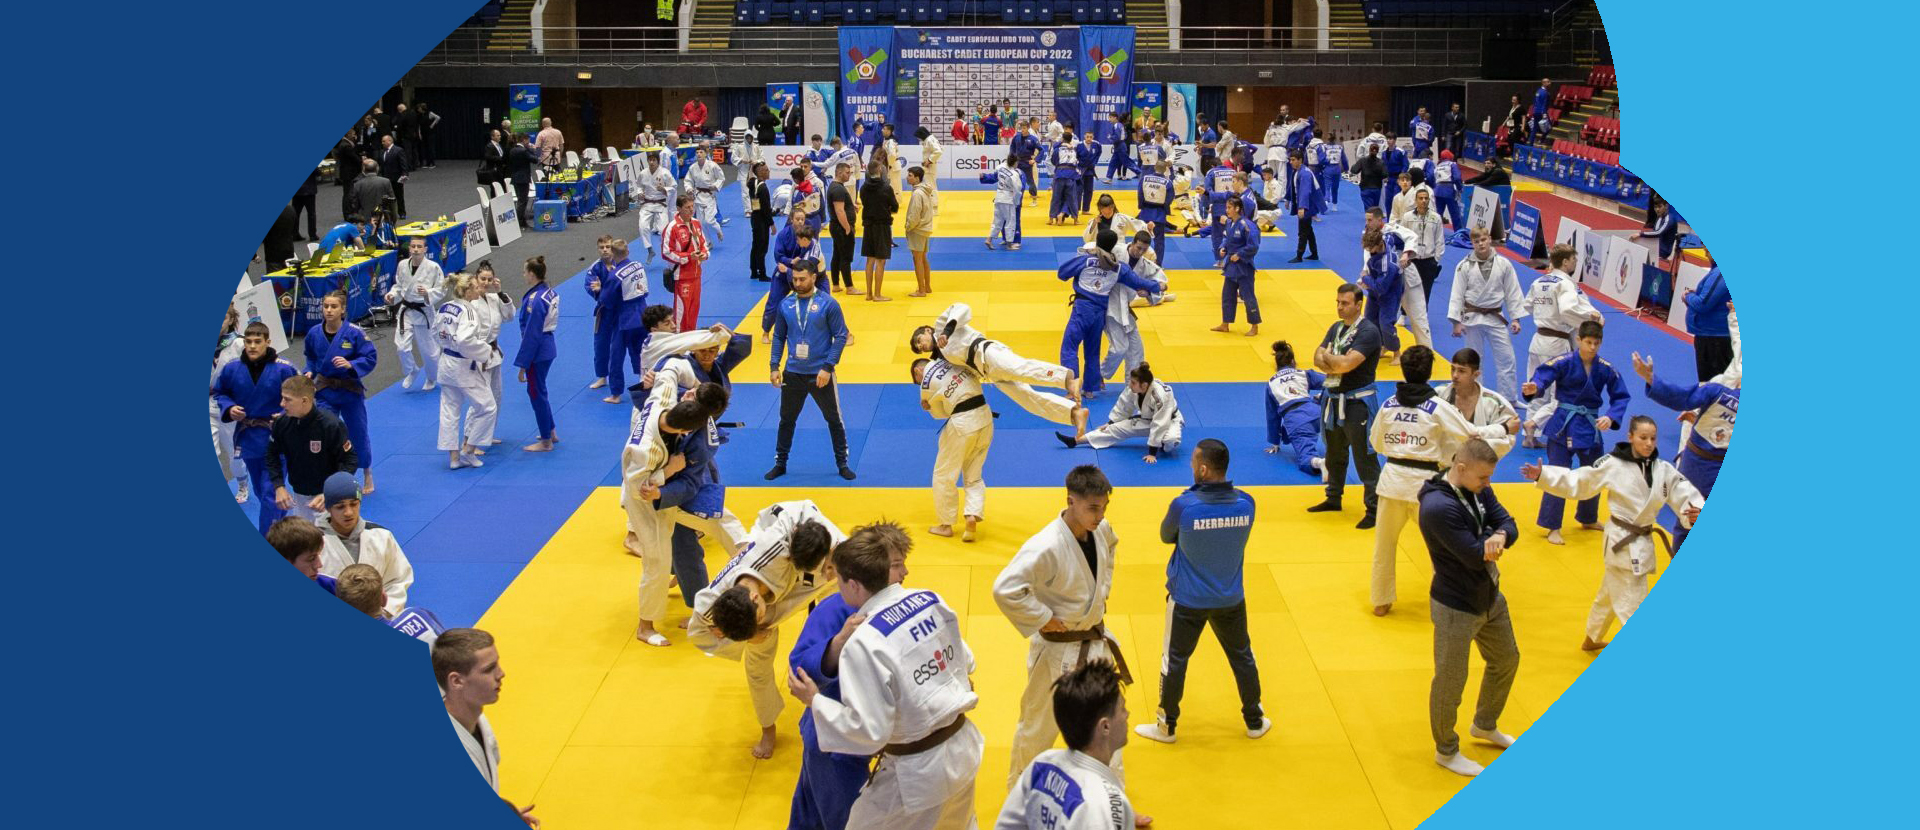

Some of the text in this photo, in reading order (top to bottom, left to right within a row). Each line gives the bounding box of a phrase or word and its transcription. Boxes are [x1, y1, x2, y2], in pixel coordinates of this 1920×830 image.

[901, 49, 1073, 59] BUCHAREST CADET EUROPEAN CUP 2022
[847, 95, 888, 104] EUROPEAN
[1086, 95, 1126, 104] EUROPEAN
[1096, 104, 1115, 112] JUDO
[854, 113, 879, 121] UION
[466, 219, 484, 235] GREEN
[468, 230, 485, 247] HILL
[936, 365, 953, 381] AZE
[943, 371, 969, 398] essim
[1394, 412, 1418, 423] AZE
[1384, 431, 1428, 446] essimo
[1193, 515, 1250, 531] AZERBAIJAN
[881, 593, 934, 626] HUKKANEN
[909, 615, 938, 642] FIN
